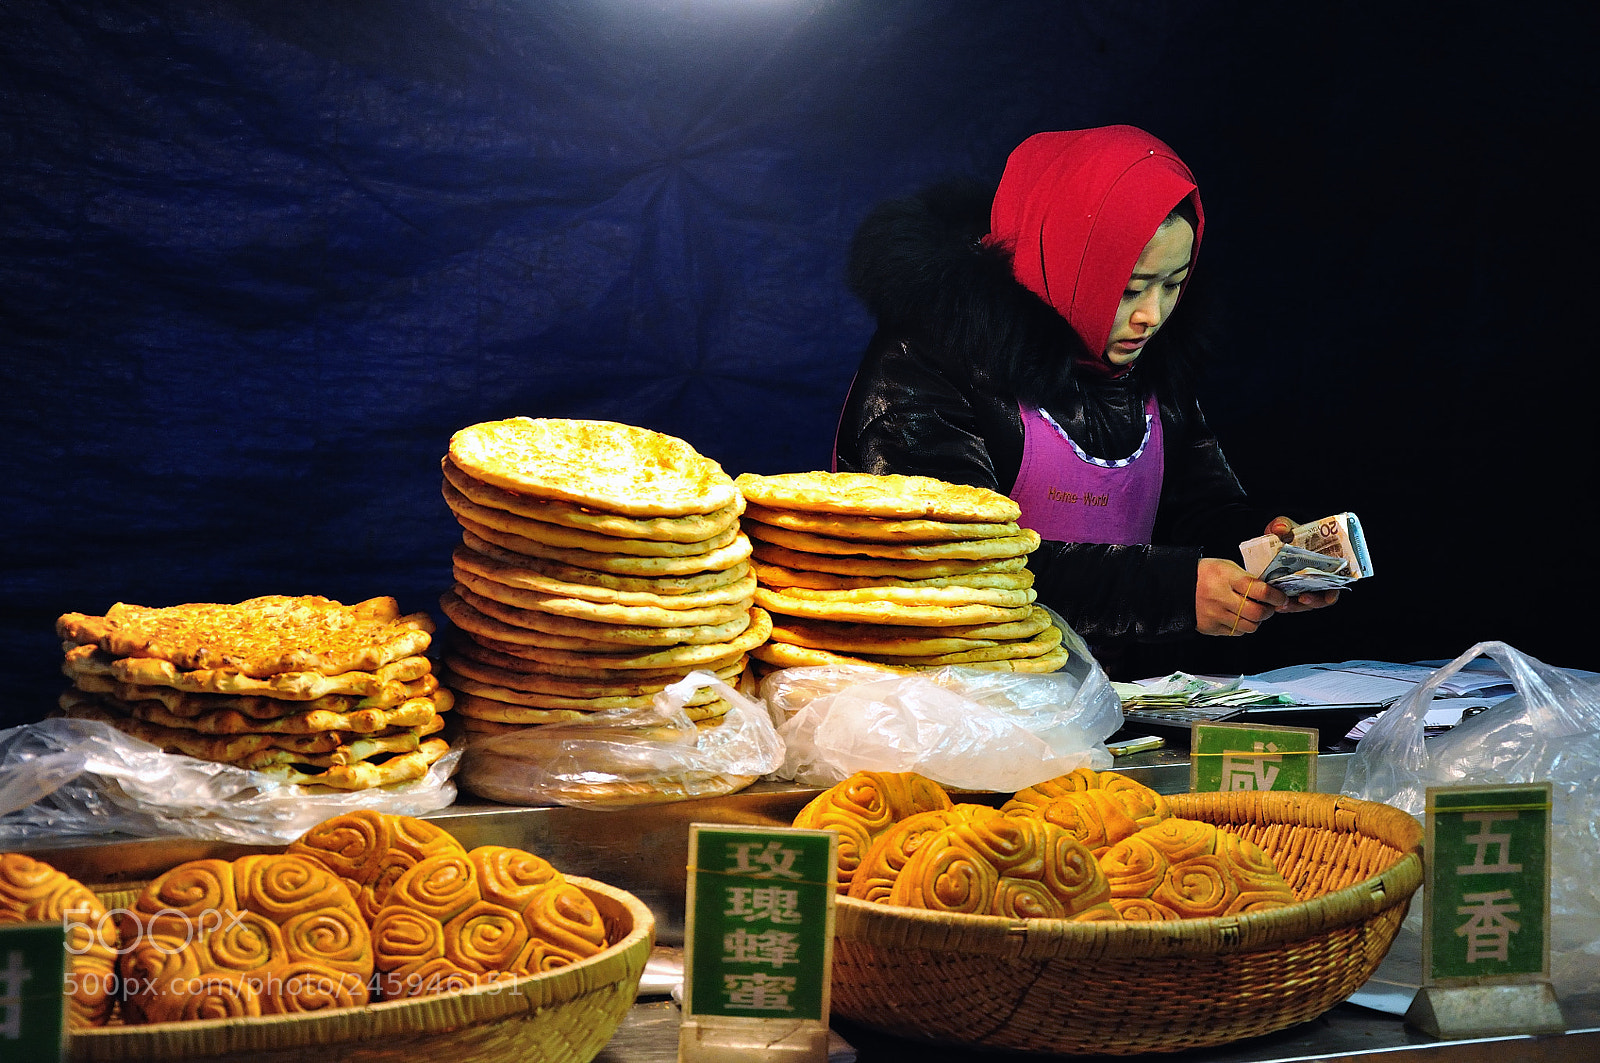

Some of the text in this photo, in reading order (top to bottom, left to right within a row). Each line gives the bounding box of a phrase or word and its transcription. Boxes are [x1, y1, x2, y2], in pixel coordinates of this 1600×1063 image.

[1047, 486, 1078, 504] Home
[1320, 520, 1339, 538] 20
[1219, 741, 1283, 792] 咸
[1454, 811, 1523, 963] 五香
[721, 841, 804, 1011] 玫瑰蜂蜜
